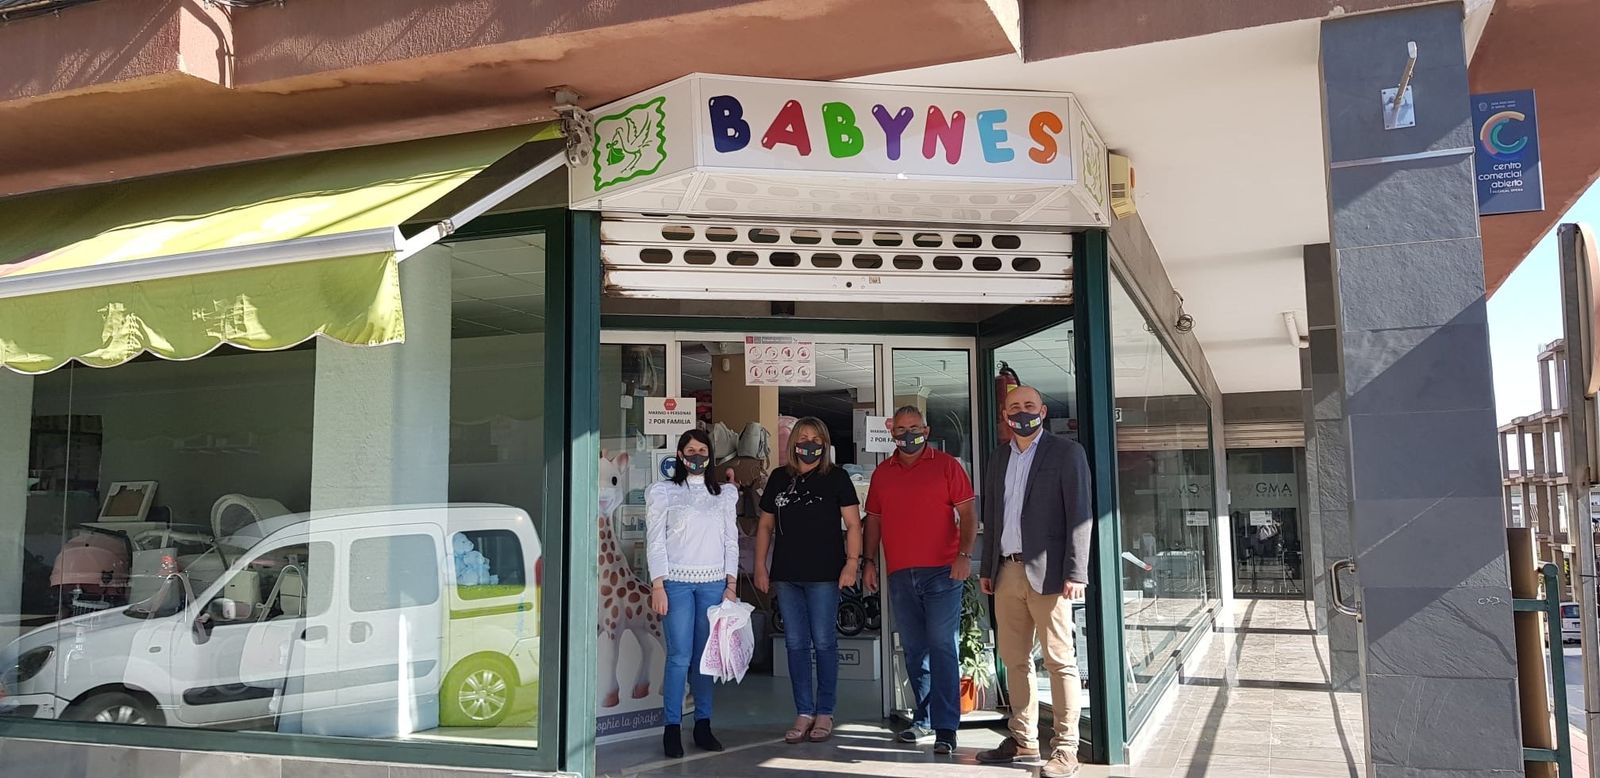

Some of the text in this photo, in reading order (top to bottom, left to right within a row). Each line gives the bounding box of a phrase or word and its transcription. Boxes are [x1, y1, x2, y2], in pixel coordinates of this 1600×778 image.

[708, 95, 1063, 165] BABYNES
[1493, 162, 1521, 170] centro
[1478, 170, 1522, 180] comercial
[1491, 180, 1523, 188] abierto
[1255, 482, 1292, 493] GMA
[596, 717, 620, 733] ophie
[621, 715, 631, 726] la
